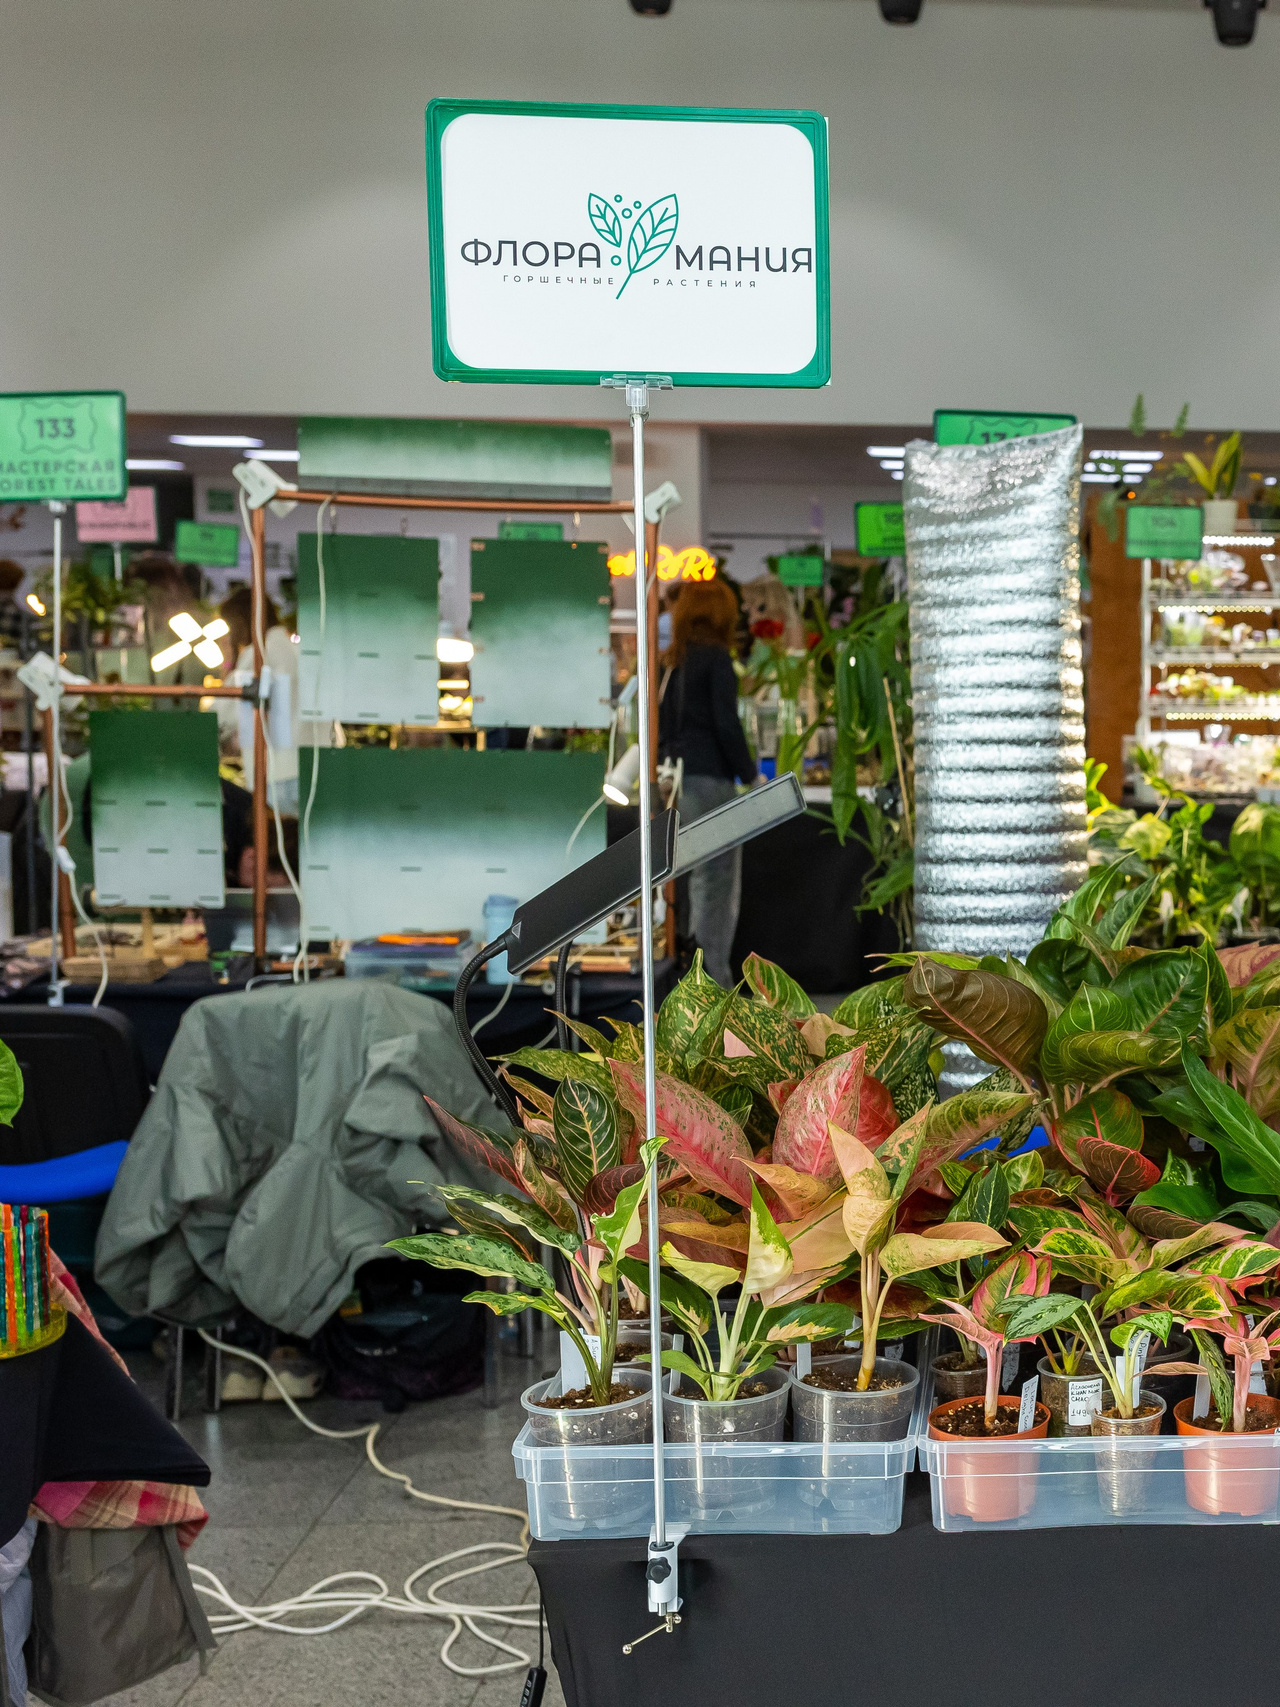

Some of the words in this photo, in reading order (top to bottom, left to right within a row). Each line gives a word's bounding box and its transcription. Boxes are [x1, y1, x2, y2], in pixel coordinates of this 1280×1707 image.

[460, 238, 601, 268] ФЛОРА
[675, 244, 813, 273] МАНИЯ
[503, 274, 615, 286] ГОРШЕЧНЫЕ
[653, 278, 757, 288] РАСТЕНИЯ
[35, 417, 76, 439] 133
[0, 459, 115, 475] АСТЕРСКАЯ
